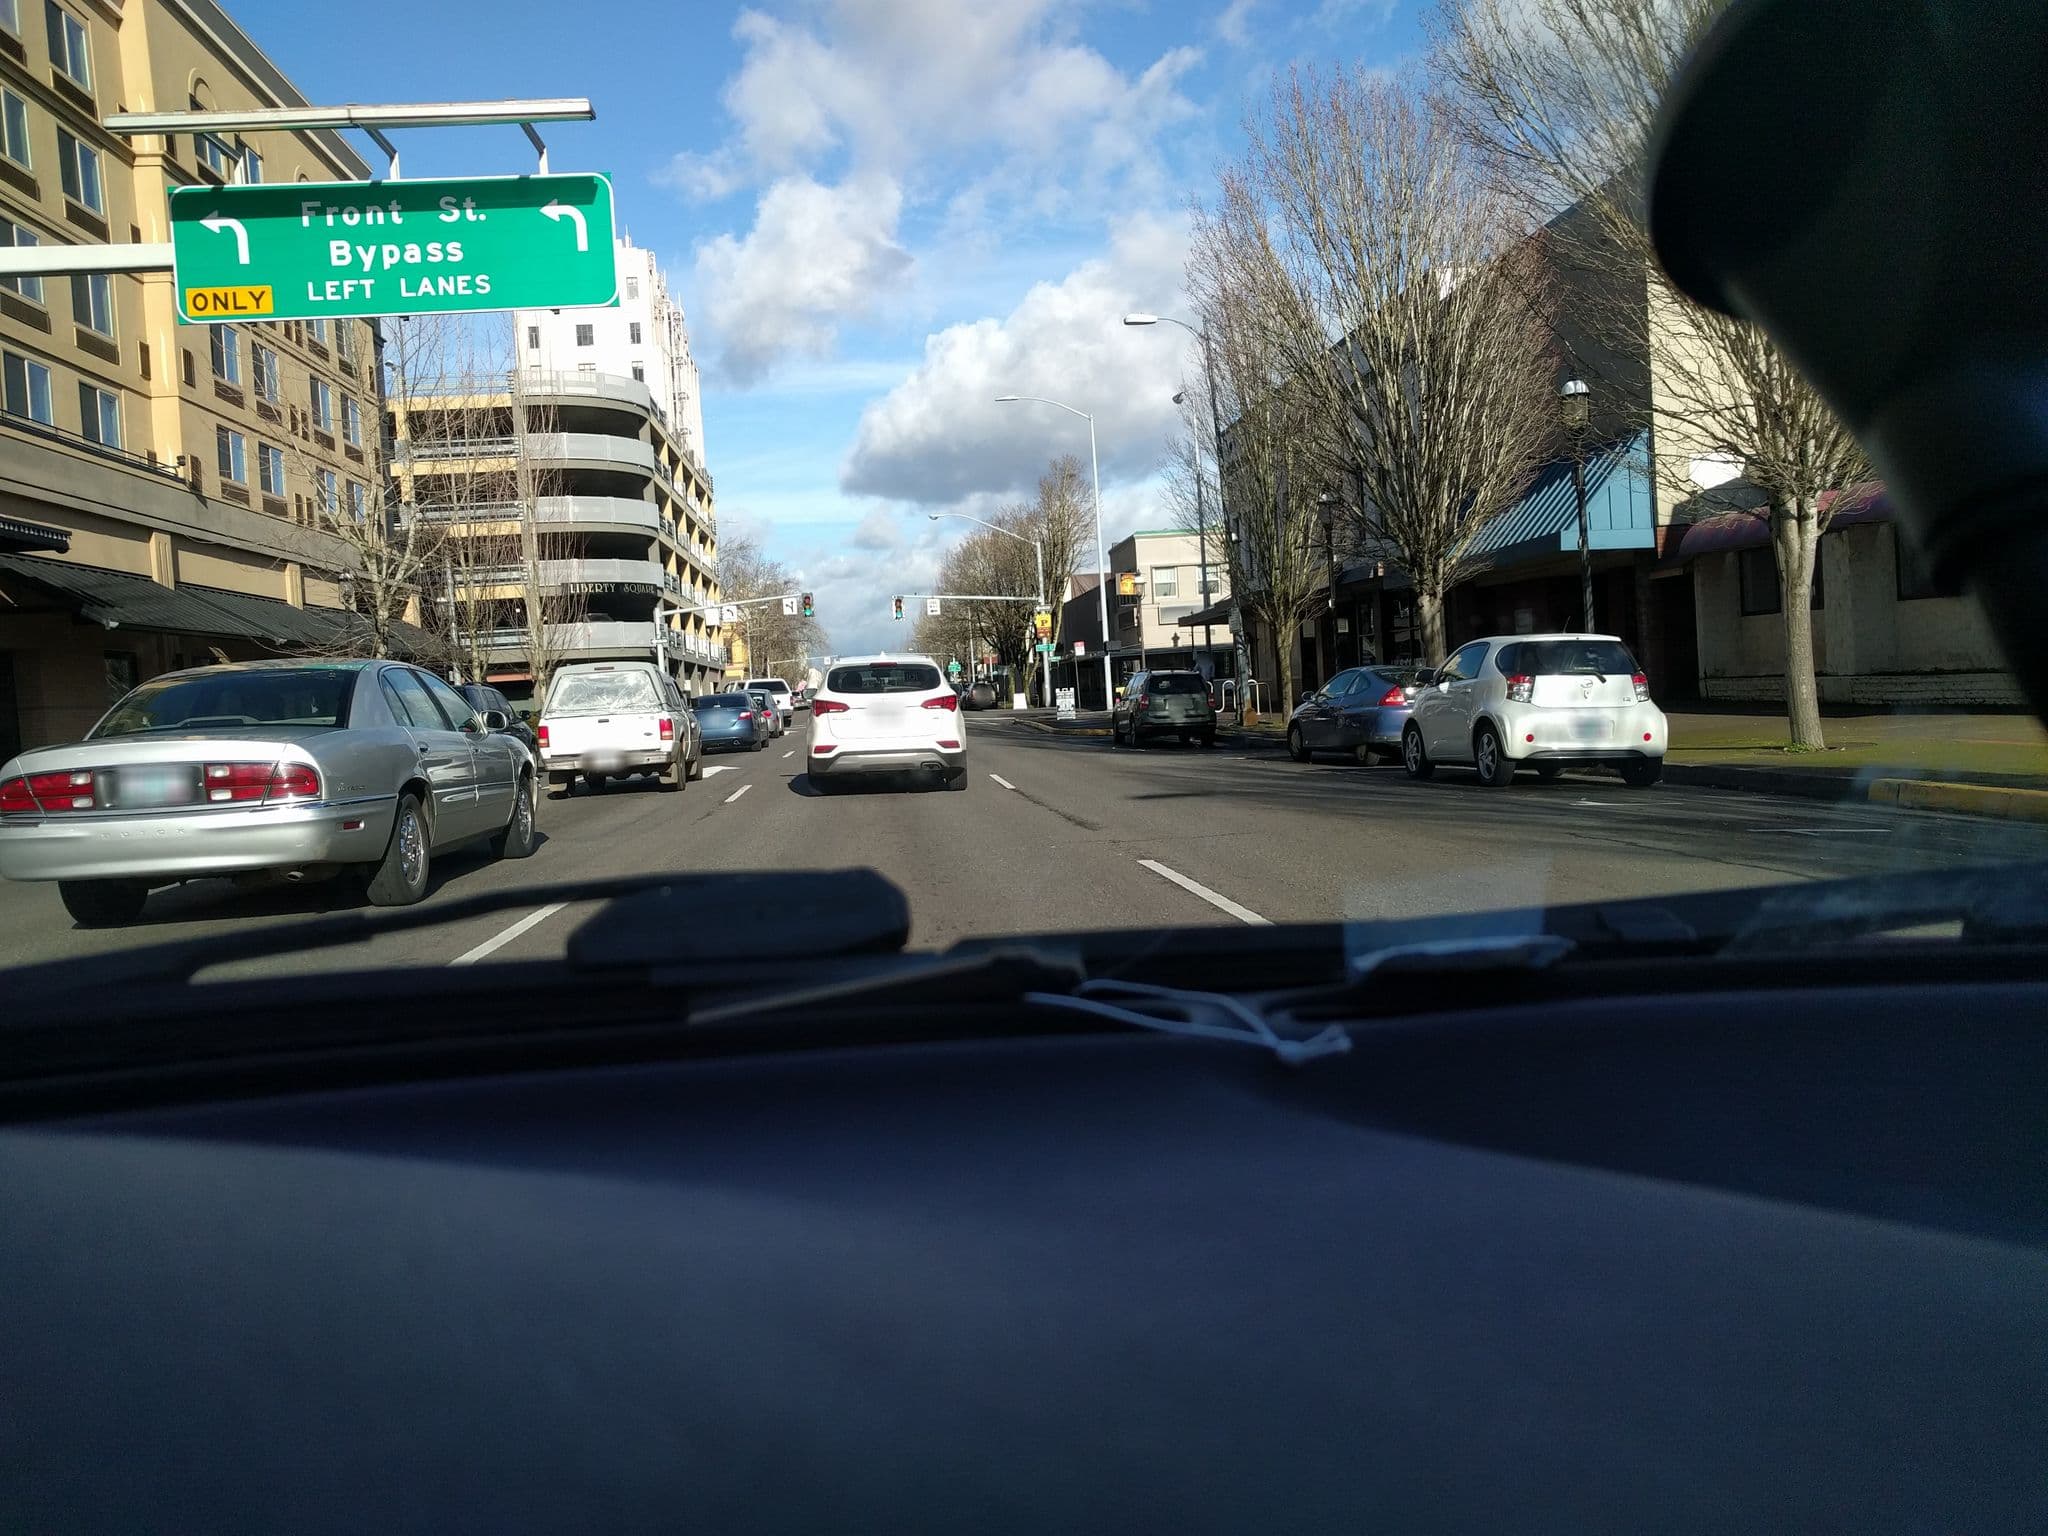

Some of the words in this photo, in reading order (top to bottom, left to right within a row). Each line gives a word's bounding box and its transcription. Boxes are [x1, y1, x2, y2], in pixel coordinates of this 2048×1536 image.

[301, 199, 404, 228] Front
[438, 196, 487, 223] St.
[329, 240, 464, 272] Bypass
[192, 290, 266, 312] ONLY
[307, 278, 376, 301] LEFT
[400, 274, 491, 297] LANES
[570, 583, 616, 594] LIBERTY
[623, 583, 654, 595] SQUARE
